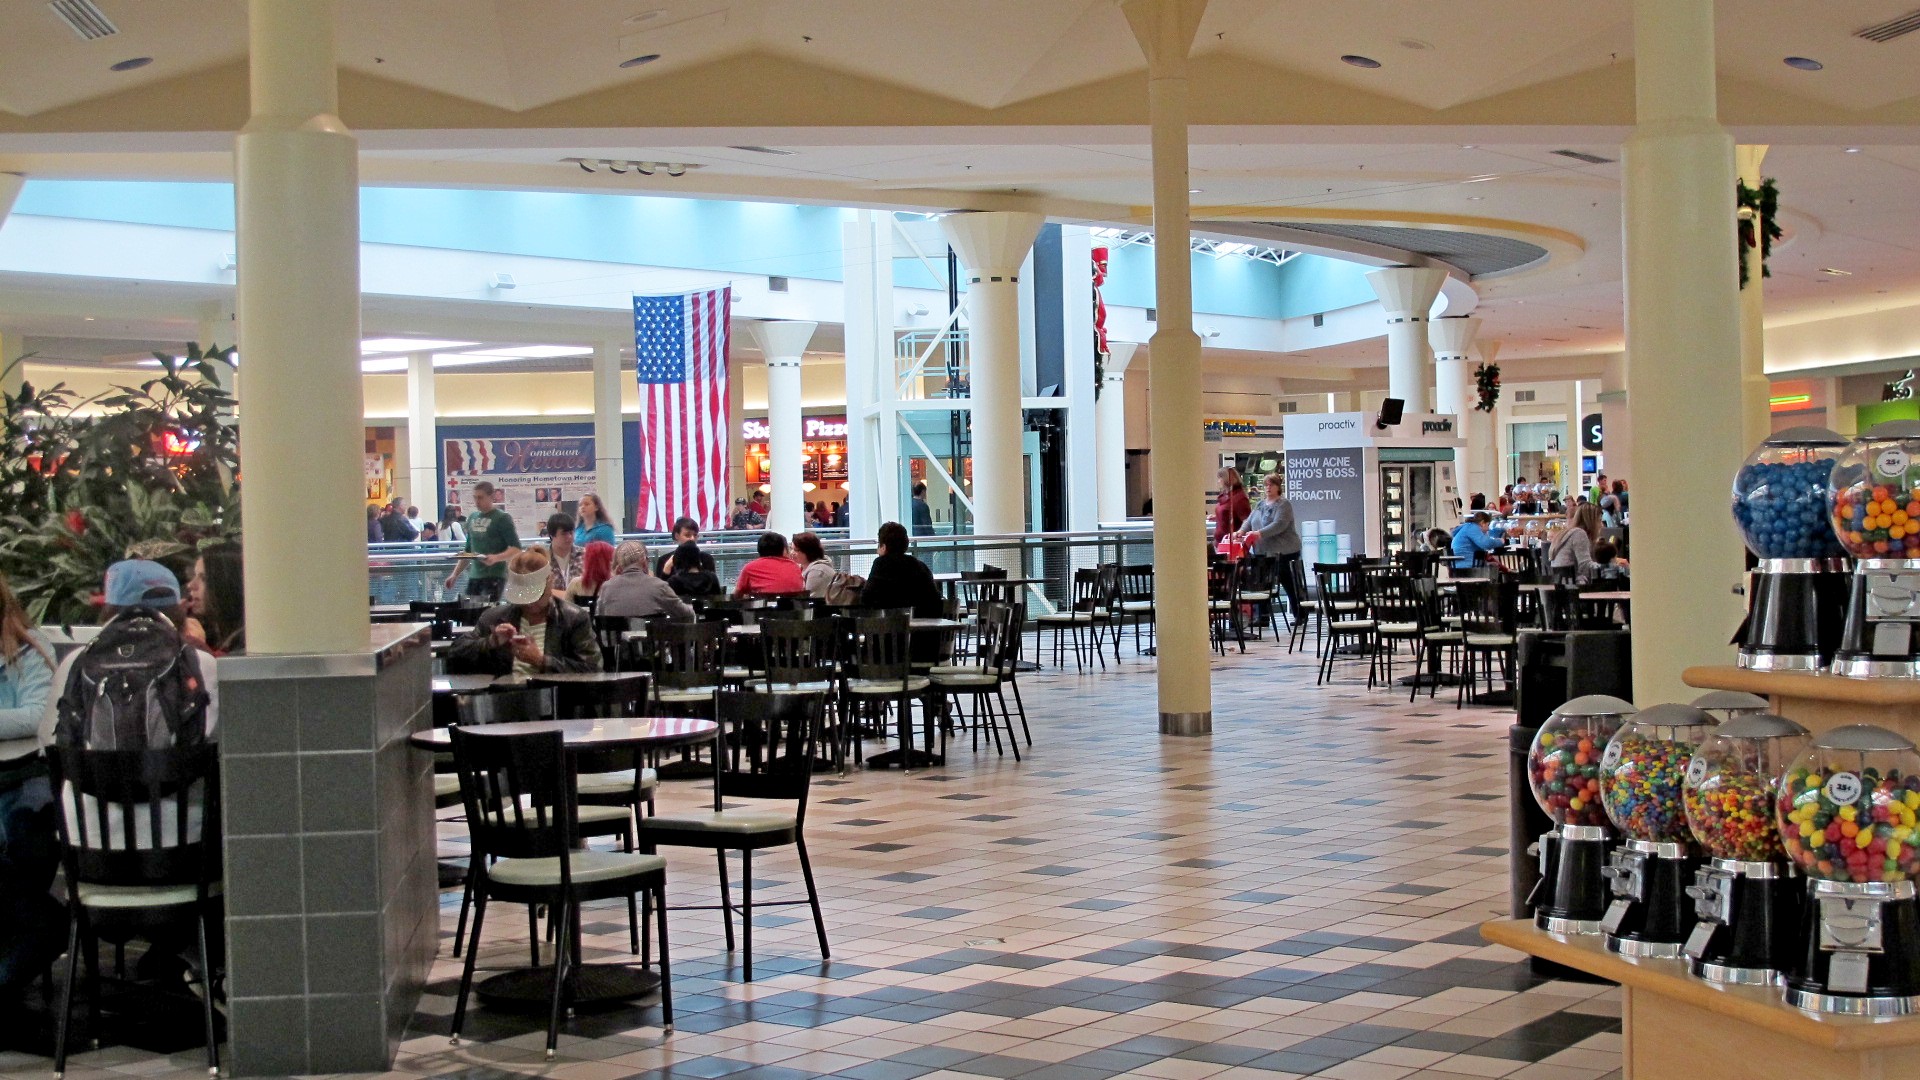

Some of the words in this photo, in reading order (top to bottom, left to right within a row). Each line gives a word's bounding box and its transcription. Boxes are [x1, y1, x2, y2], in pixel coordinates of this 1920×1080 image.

[1318, 419, 1356, 432] proactiv
[1422, 418, 1452, 435] proactiv
[1288, 457, 1320, 469] SHOW
[1322, 456, 1351, 468] ACNE
[1288, 468, 1323, 479] WHO'S
[1325, 467, 1358, 478] BOSS.
[498, 476, 532, 484] Honoring
[533, 475, 572, 483] Hometown
[1288, 480, 1303, 490] BE
[1289, 489, 1342, 500] PROACTIV.
